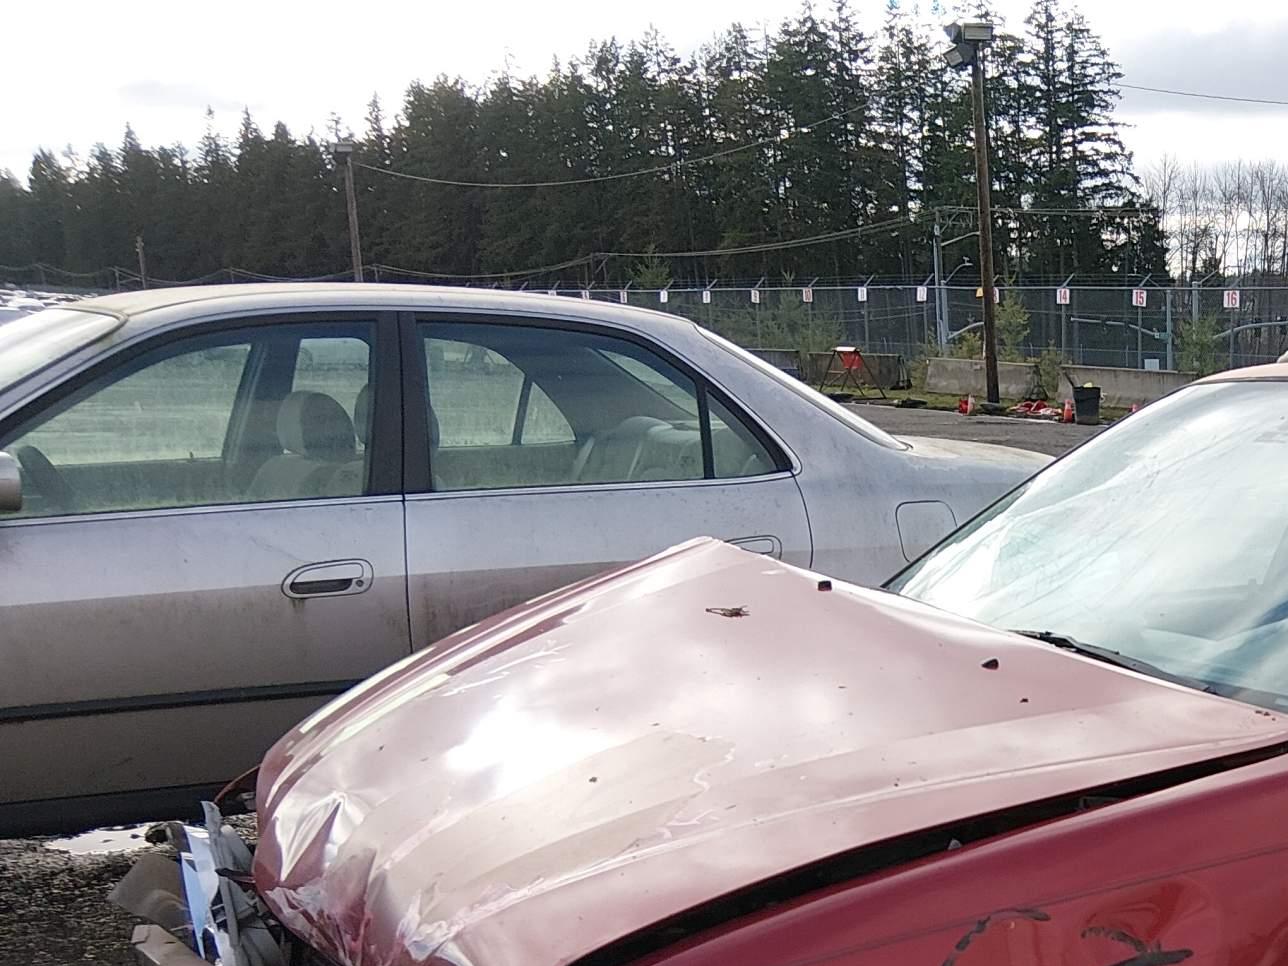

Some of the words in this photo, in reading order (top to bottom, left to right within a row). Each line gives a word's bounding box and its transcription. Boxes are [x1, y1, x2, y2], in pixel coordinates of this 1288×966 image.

[1058, 288, 1068, 303] 14
[1135, 290, 1145, 306] 15
[1225, 291, 1237, 306] 16
